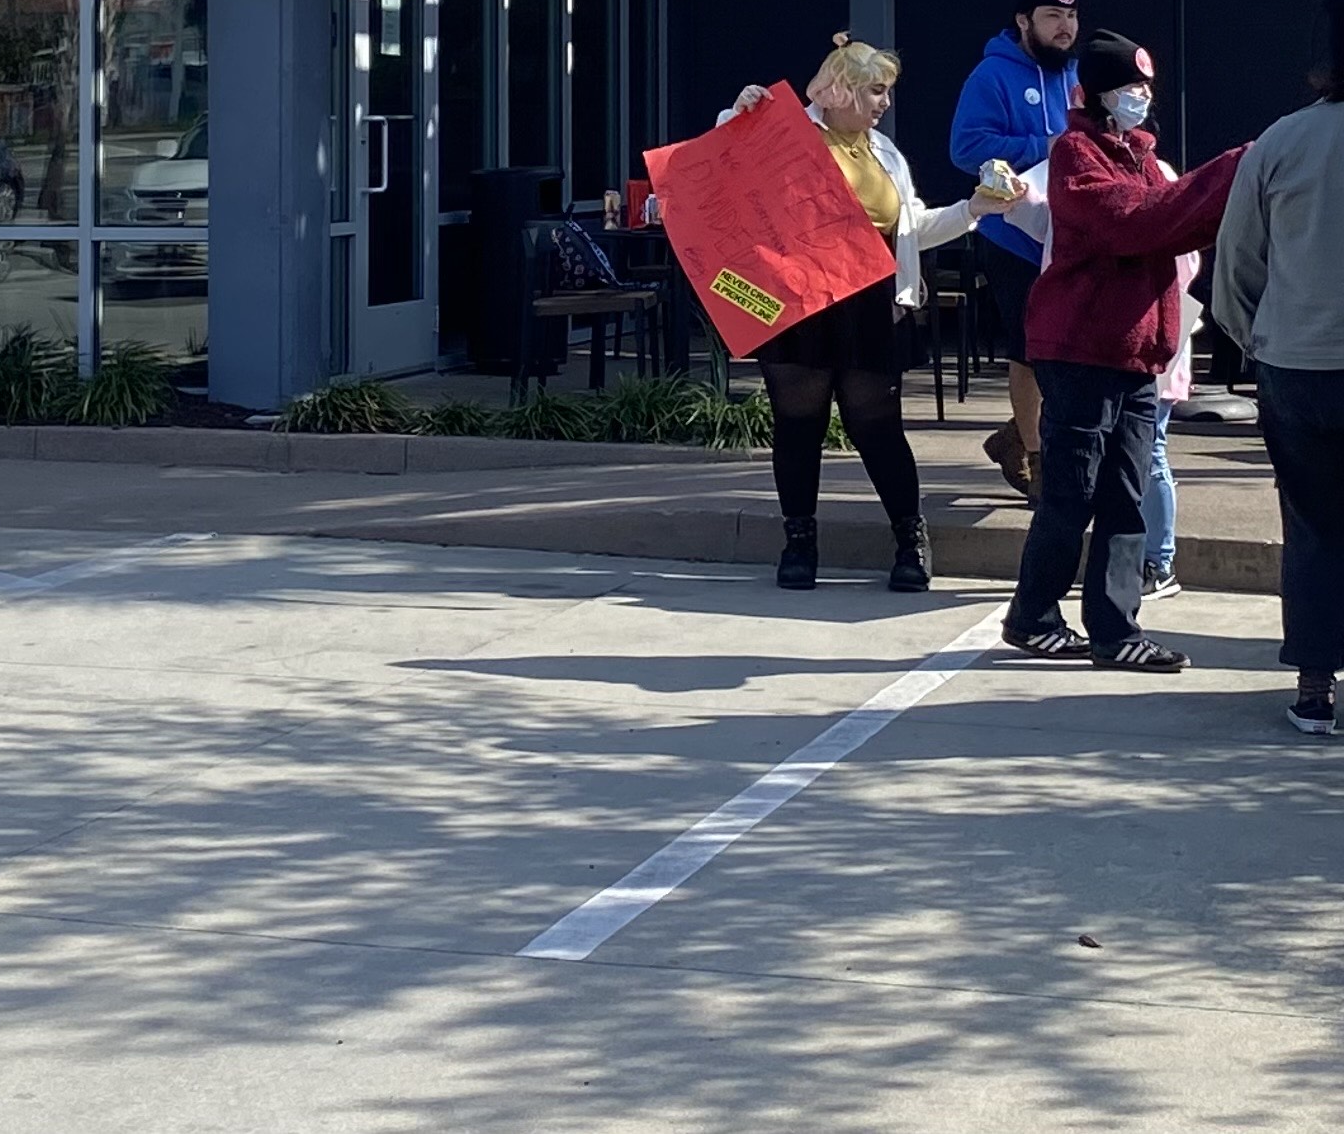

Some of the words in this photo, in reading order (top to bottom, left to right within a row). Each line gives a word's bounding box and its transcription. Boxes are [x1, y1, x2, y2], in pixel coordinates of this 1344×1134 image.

[713, 282, 721, 291] A
[720, 286, 754, 309] PICKET
[721, 270, 751, 293] NEVER
[750, 288, 781, 312] CROSS
